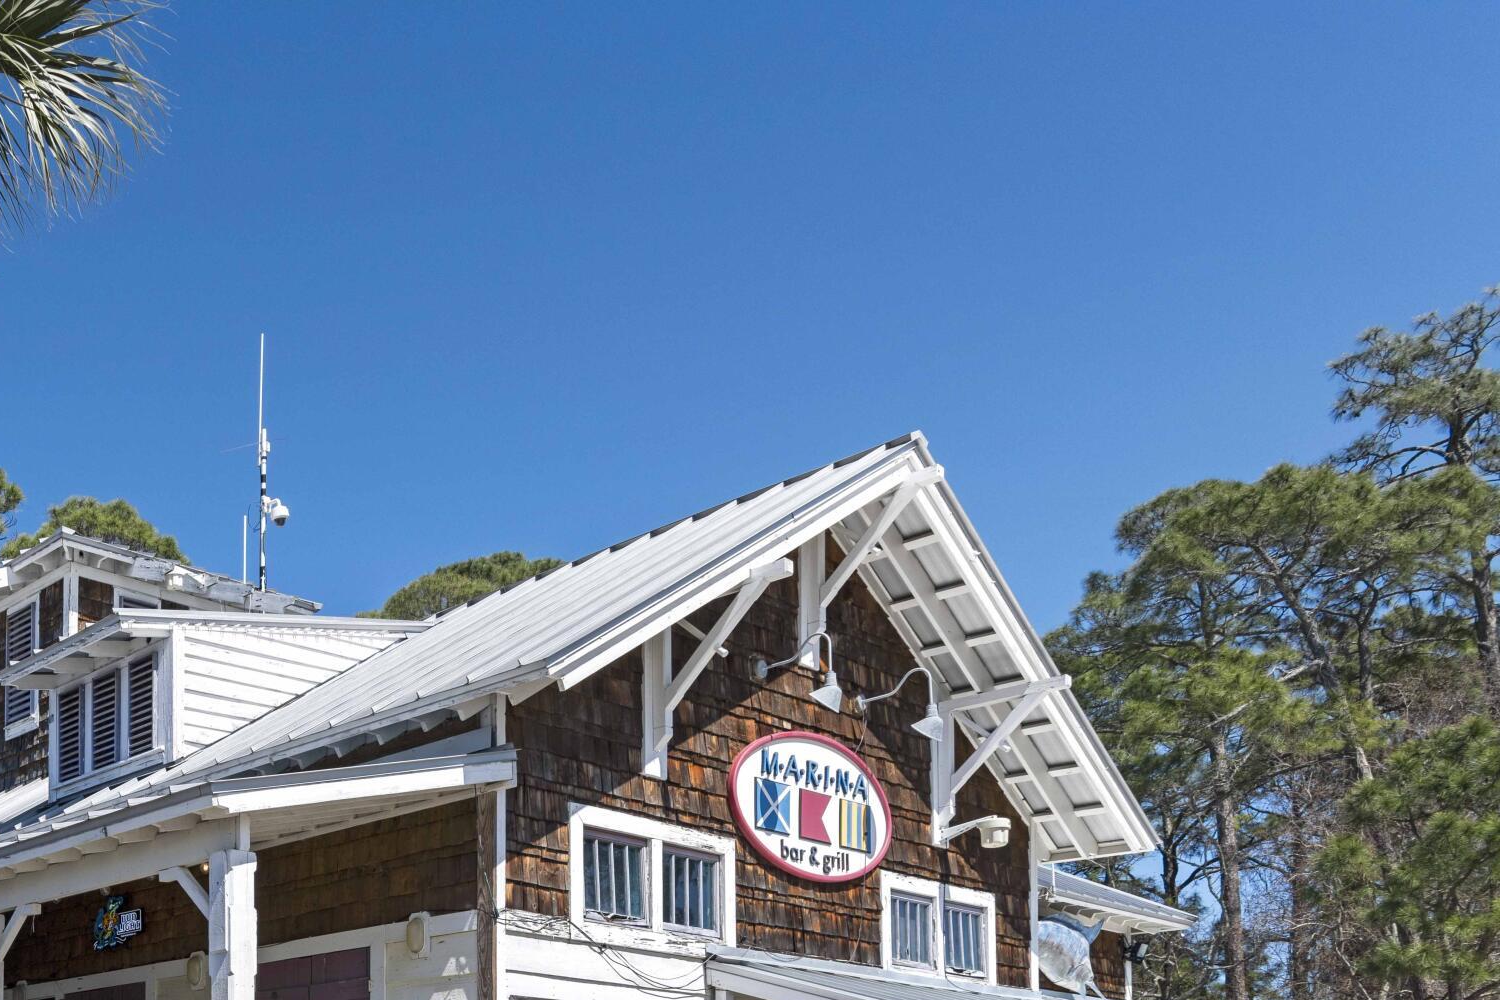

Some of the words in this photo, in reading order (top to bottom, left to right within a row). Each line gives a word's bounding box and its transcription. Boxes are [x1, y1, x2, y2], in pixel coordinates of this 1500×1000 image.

[780, 839, 806, 863] bar
[809, 846, 820, 868] &
[823, 852, 850, 875] grill
[121, 912, 137, 924] BUD
